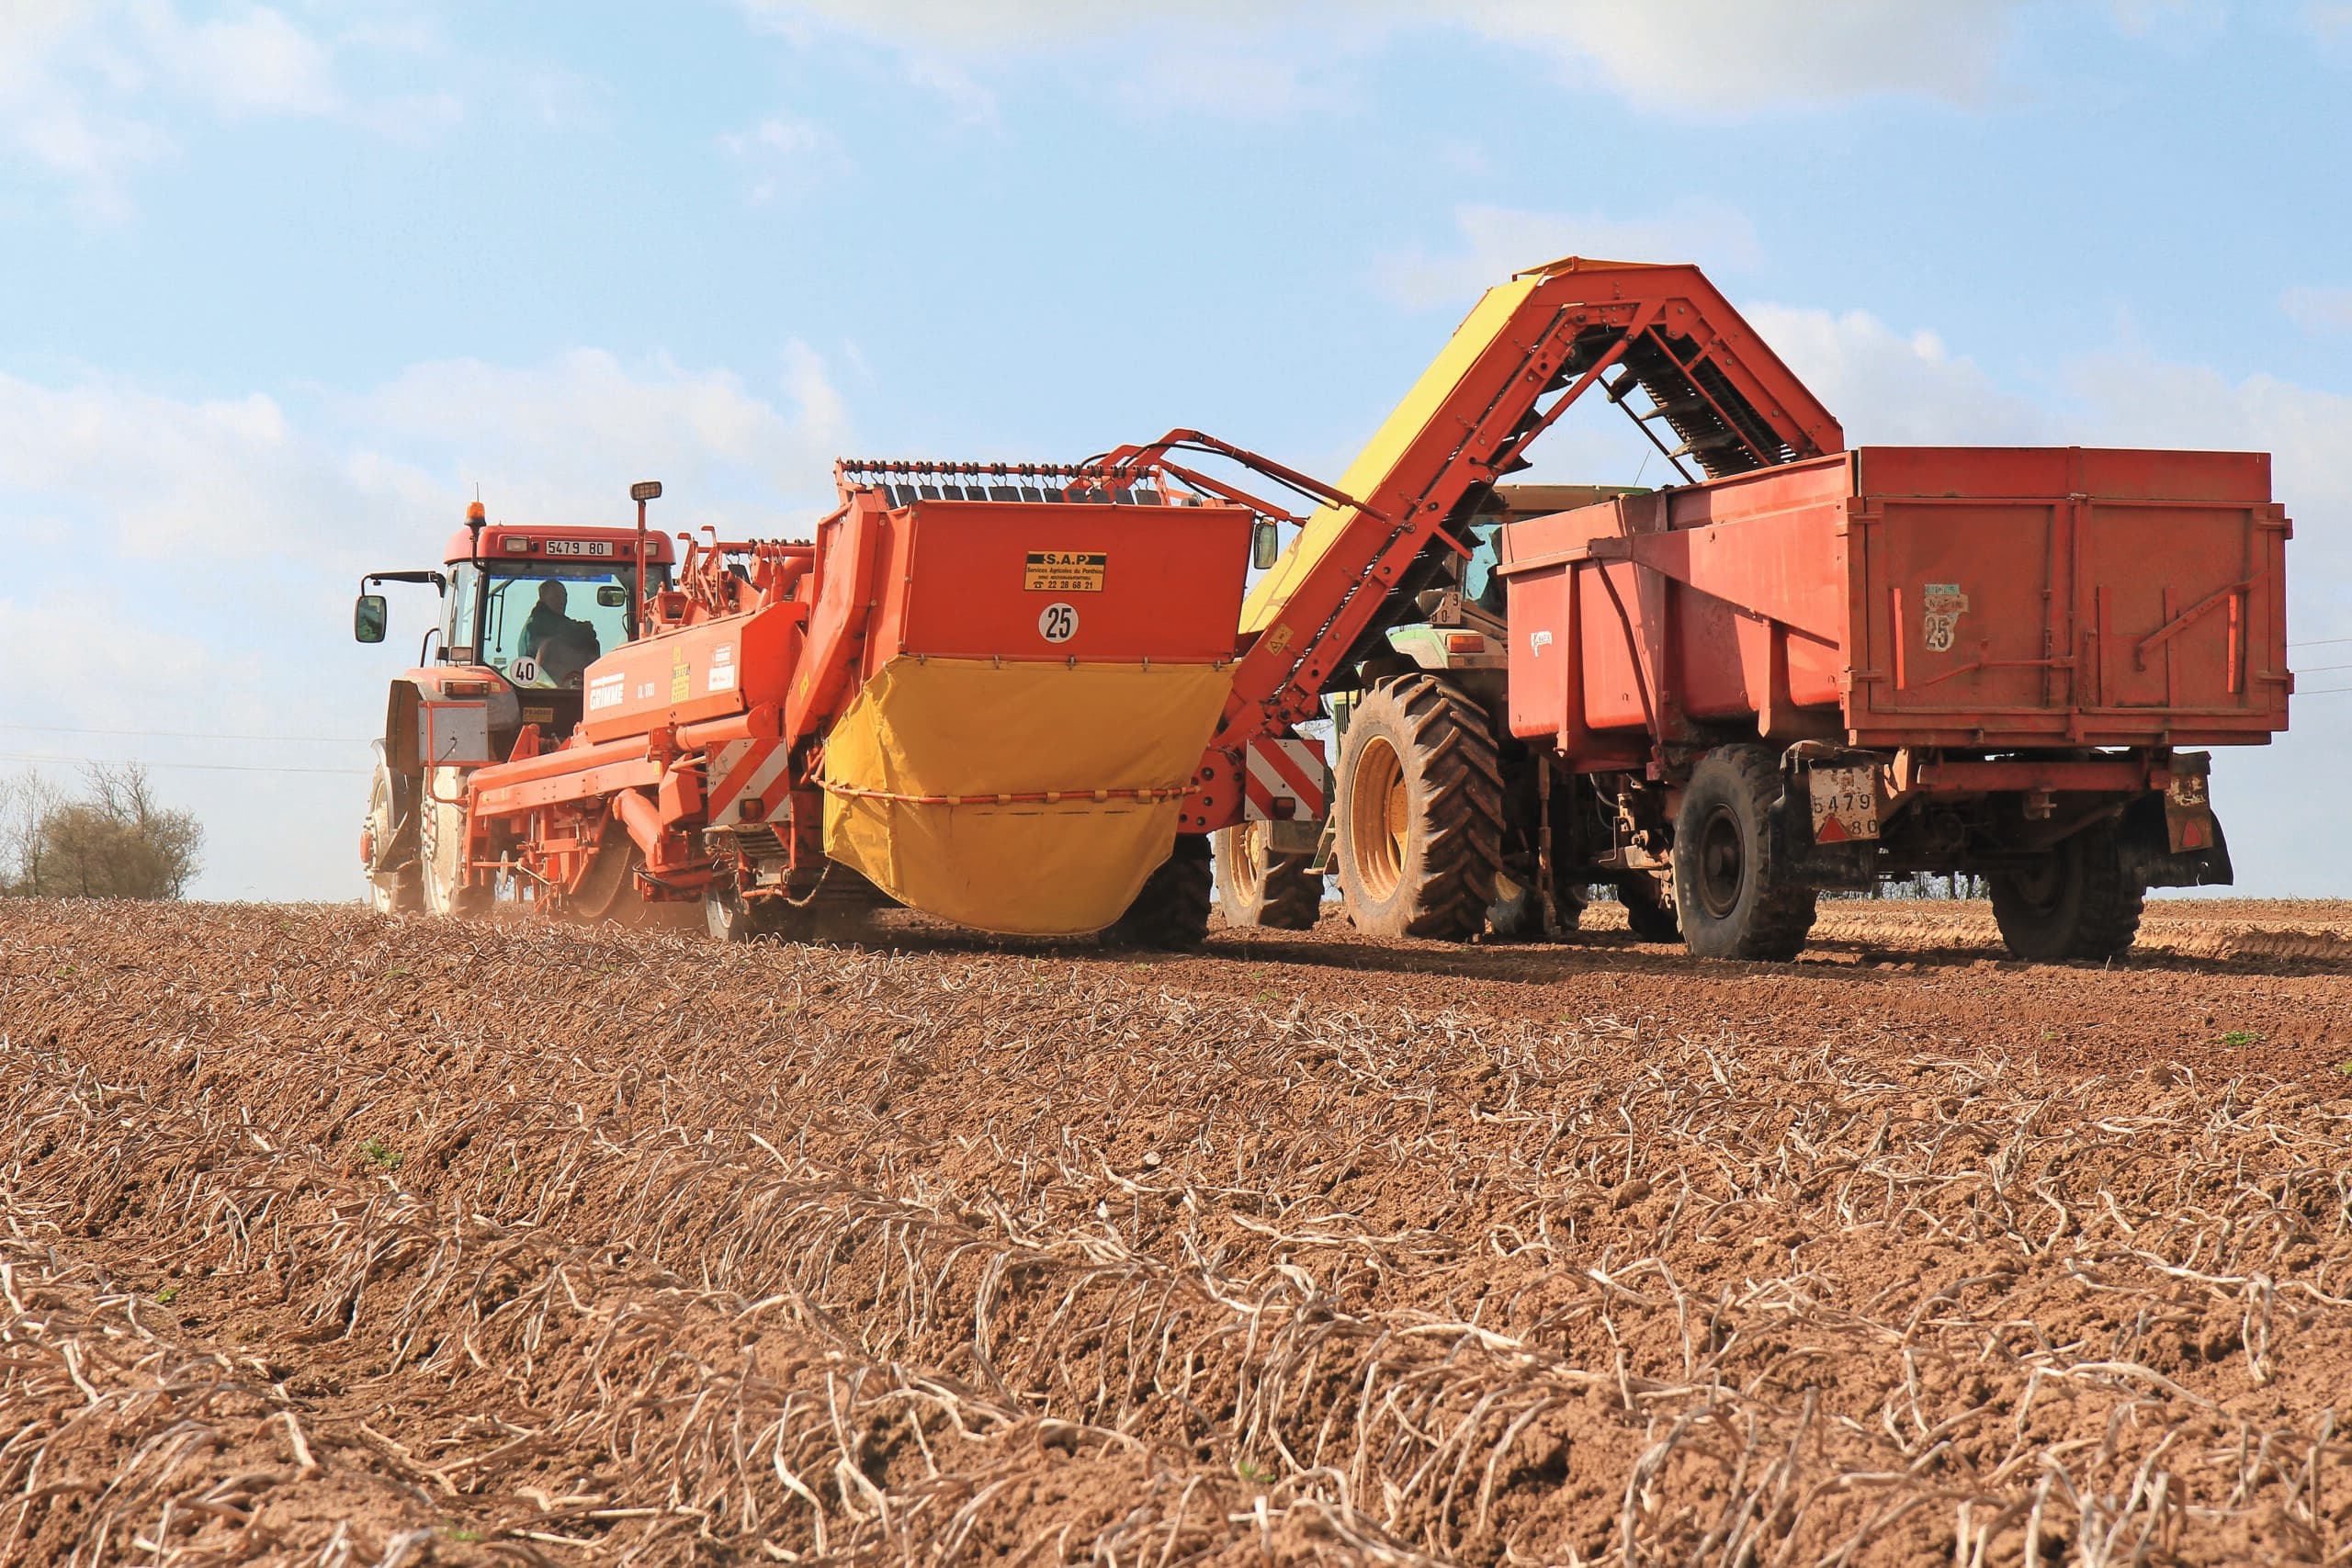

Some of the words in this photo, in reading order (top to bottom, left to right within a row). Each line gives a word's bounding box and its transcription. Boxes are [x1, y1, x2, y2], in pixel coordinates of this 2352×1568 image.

[548, 542, 580, 554] 5479
[589, 543, 604, 555] 80
[1047, 581, 1057, 589] 22
[1085, 581, 1093, 590] 21
[1046, 607, 1071, 638] 25
[515, 661, 535, 681] 40
[1814, 793, 1871, 814] 5479
[1852, 819, 1878, 835] 80
